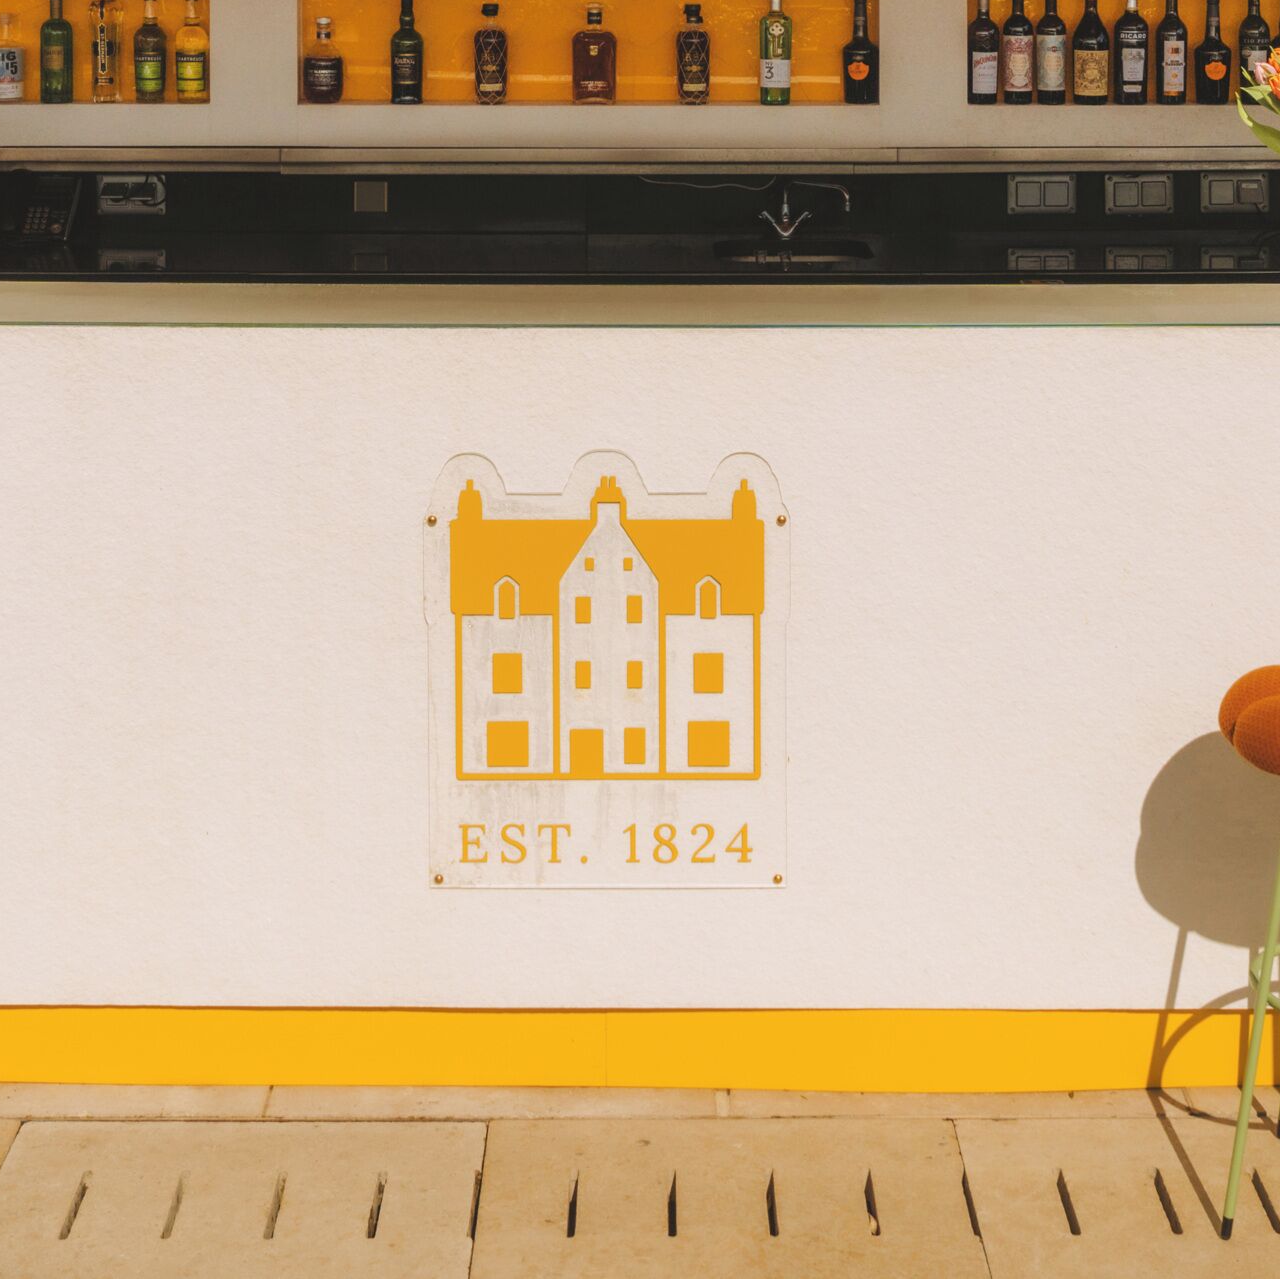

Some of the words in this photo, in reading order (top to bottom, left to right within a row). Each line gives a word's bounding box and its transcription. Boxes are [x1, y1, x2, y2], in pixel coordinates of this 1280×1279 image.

[764, 66, 774, 80] 3
[458, 823, 588, 864] EST.
[622, 823, 754, 864] 1824
